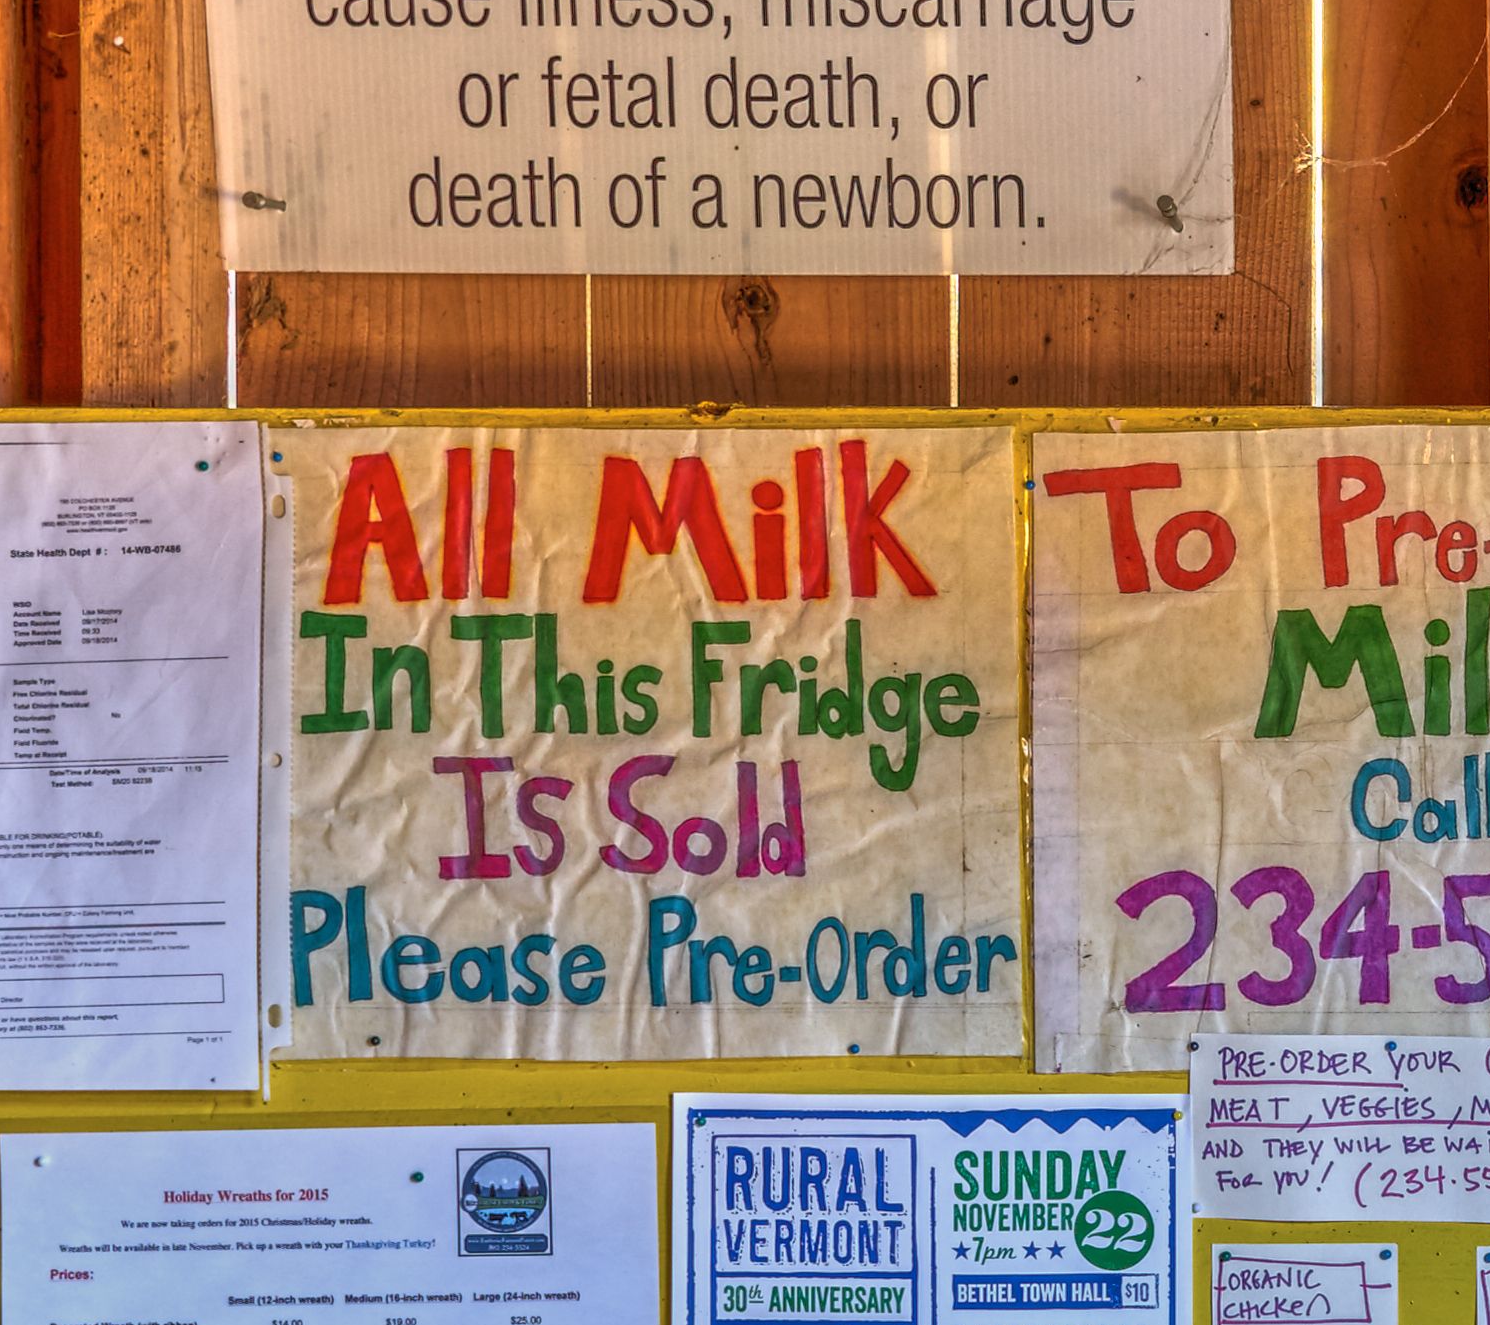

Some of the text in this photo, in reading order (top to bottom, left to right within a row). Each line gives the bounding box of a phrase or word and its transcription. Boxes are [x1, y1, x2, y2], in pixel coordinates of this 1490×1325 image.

[457, 56, 988, 140] or fetal death, or
[408, 157, 1048, 228] death of a newborn.
[323, 439, 938, 606] All Milk
[1043, 461, 1237, 594] To
[299, 611, 980, 792] In This Fridge
[432, 754, 806, 881] Is Sold
[290, 885, 606, 1007] Please
[648, 893, 1017, 1007] Pre-Order
[163, 1188, 329, 1204] Holiday Wreaths for 2015
[724, 1146, 907, 1213] RURAL
[952, 1149, 1125, 1202] SUNDAY
[723, 1219, 905, 1267] VERMONT
[952, 1203, 1149, 1252] NOVEMBER 22
[973, 1238, 1018, 1265] 7pm
[722, 1278, 905, 1313] 30th ANNIVERSARY
[956, 1278, 1150, 1305] BETHEL TOWN HALL $10
[1227, 1269, 1320, 1292] ORGANIC
